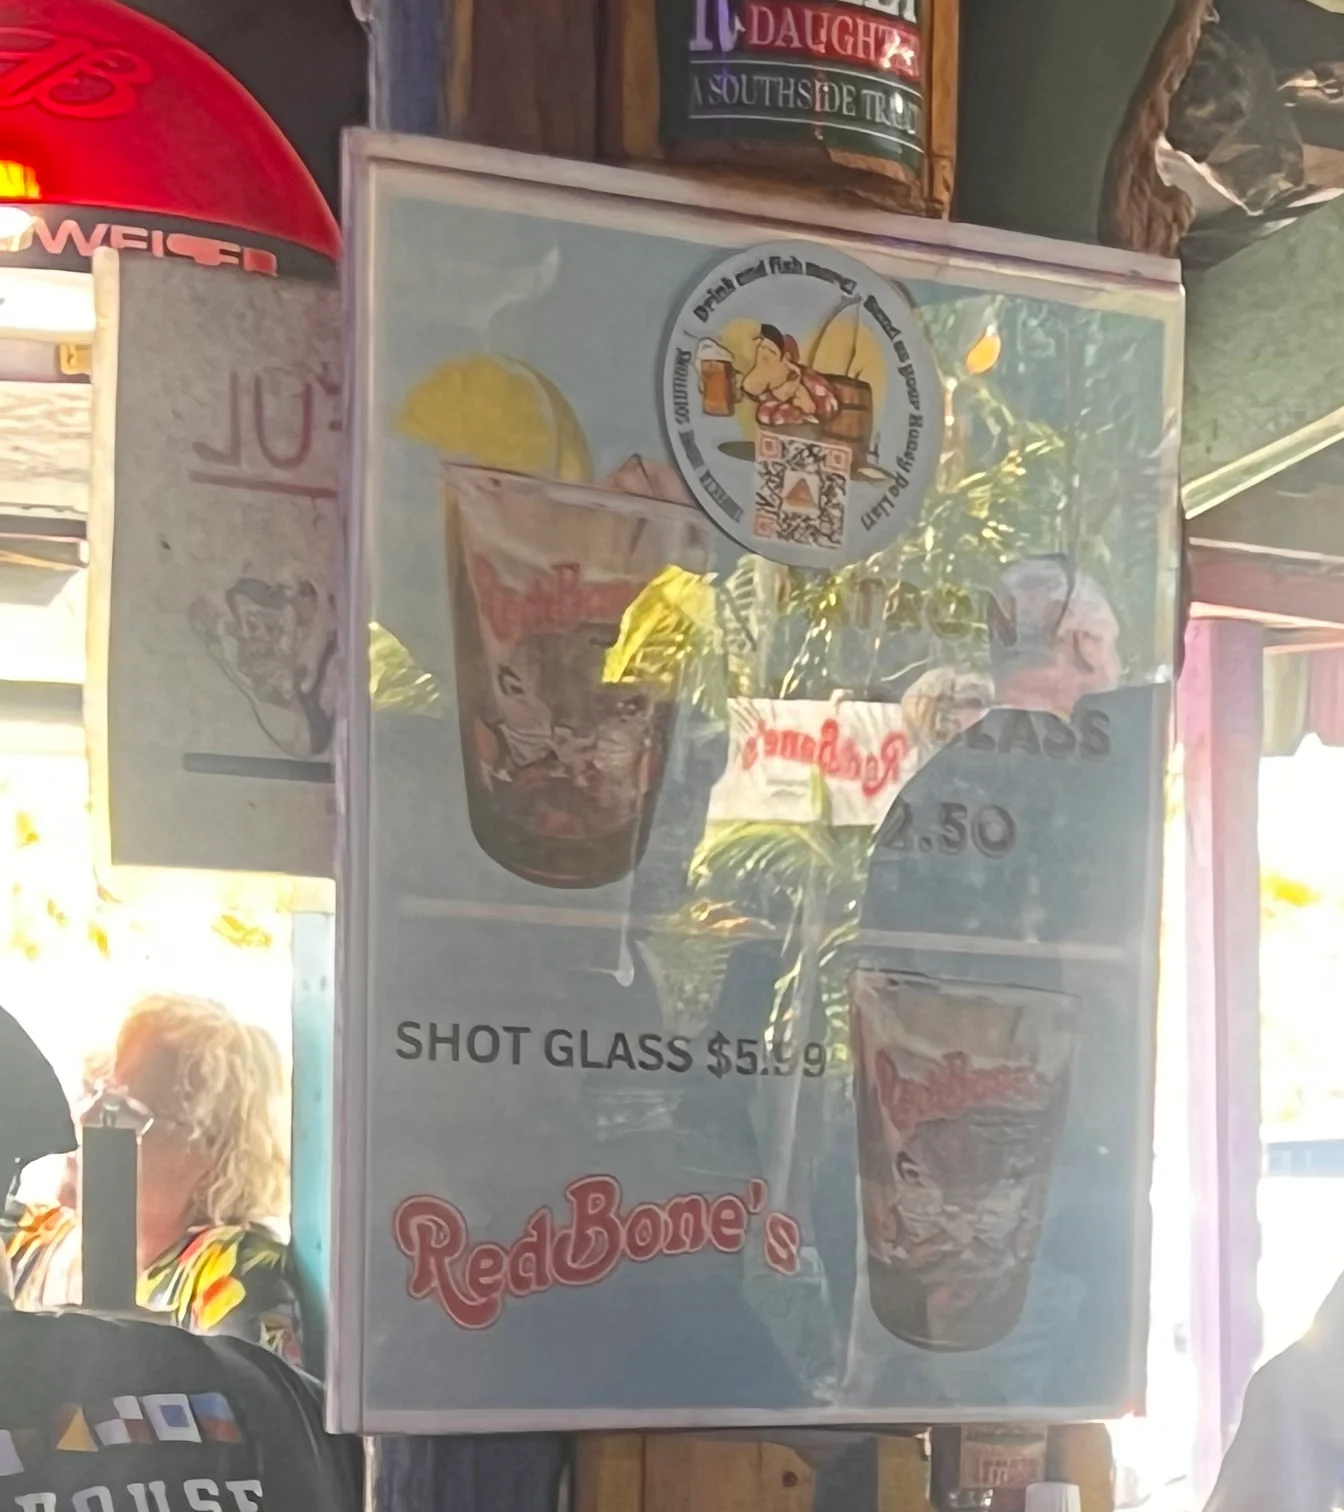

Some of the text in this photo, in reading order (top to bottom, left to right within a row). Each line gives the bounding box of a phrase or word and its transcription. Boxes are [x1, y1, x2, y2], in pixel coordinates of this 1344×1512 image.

[940, 706, 1113, 762] LASS
[395, 1020, 531, 1065] SHOT
[543, 1028, 693, 1073] GLASS
[394, 1173, 802, 1331] RedBone's
